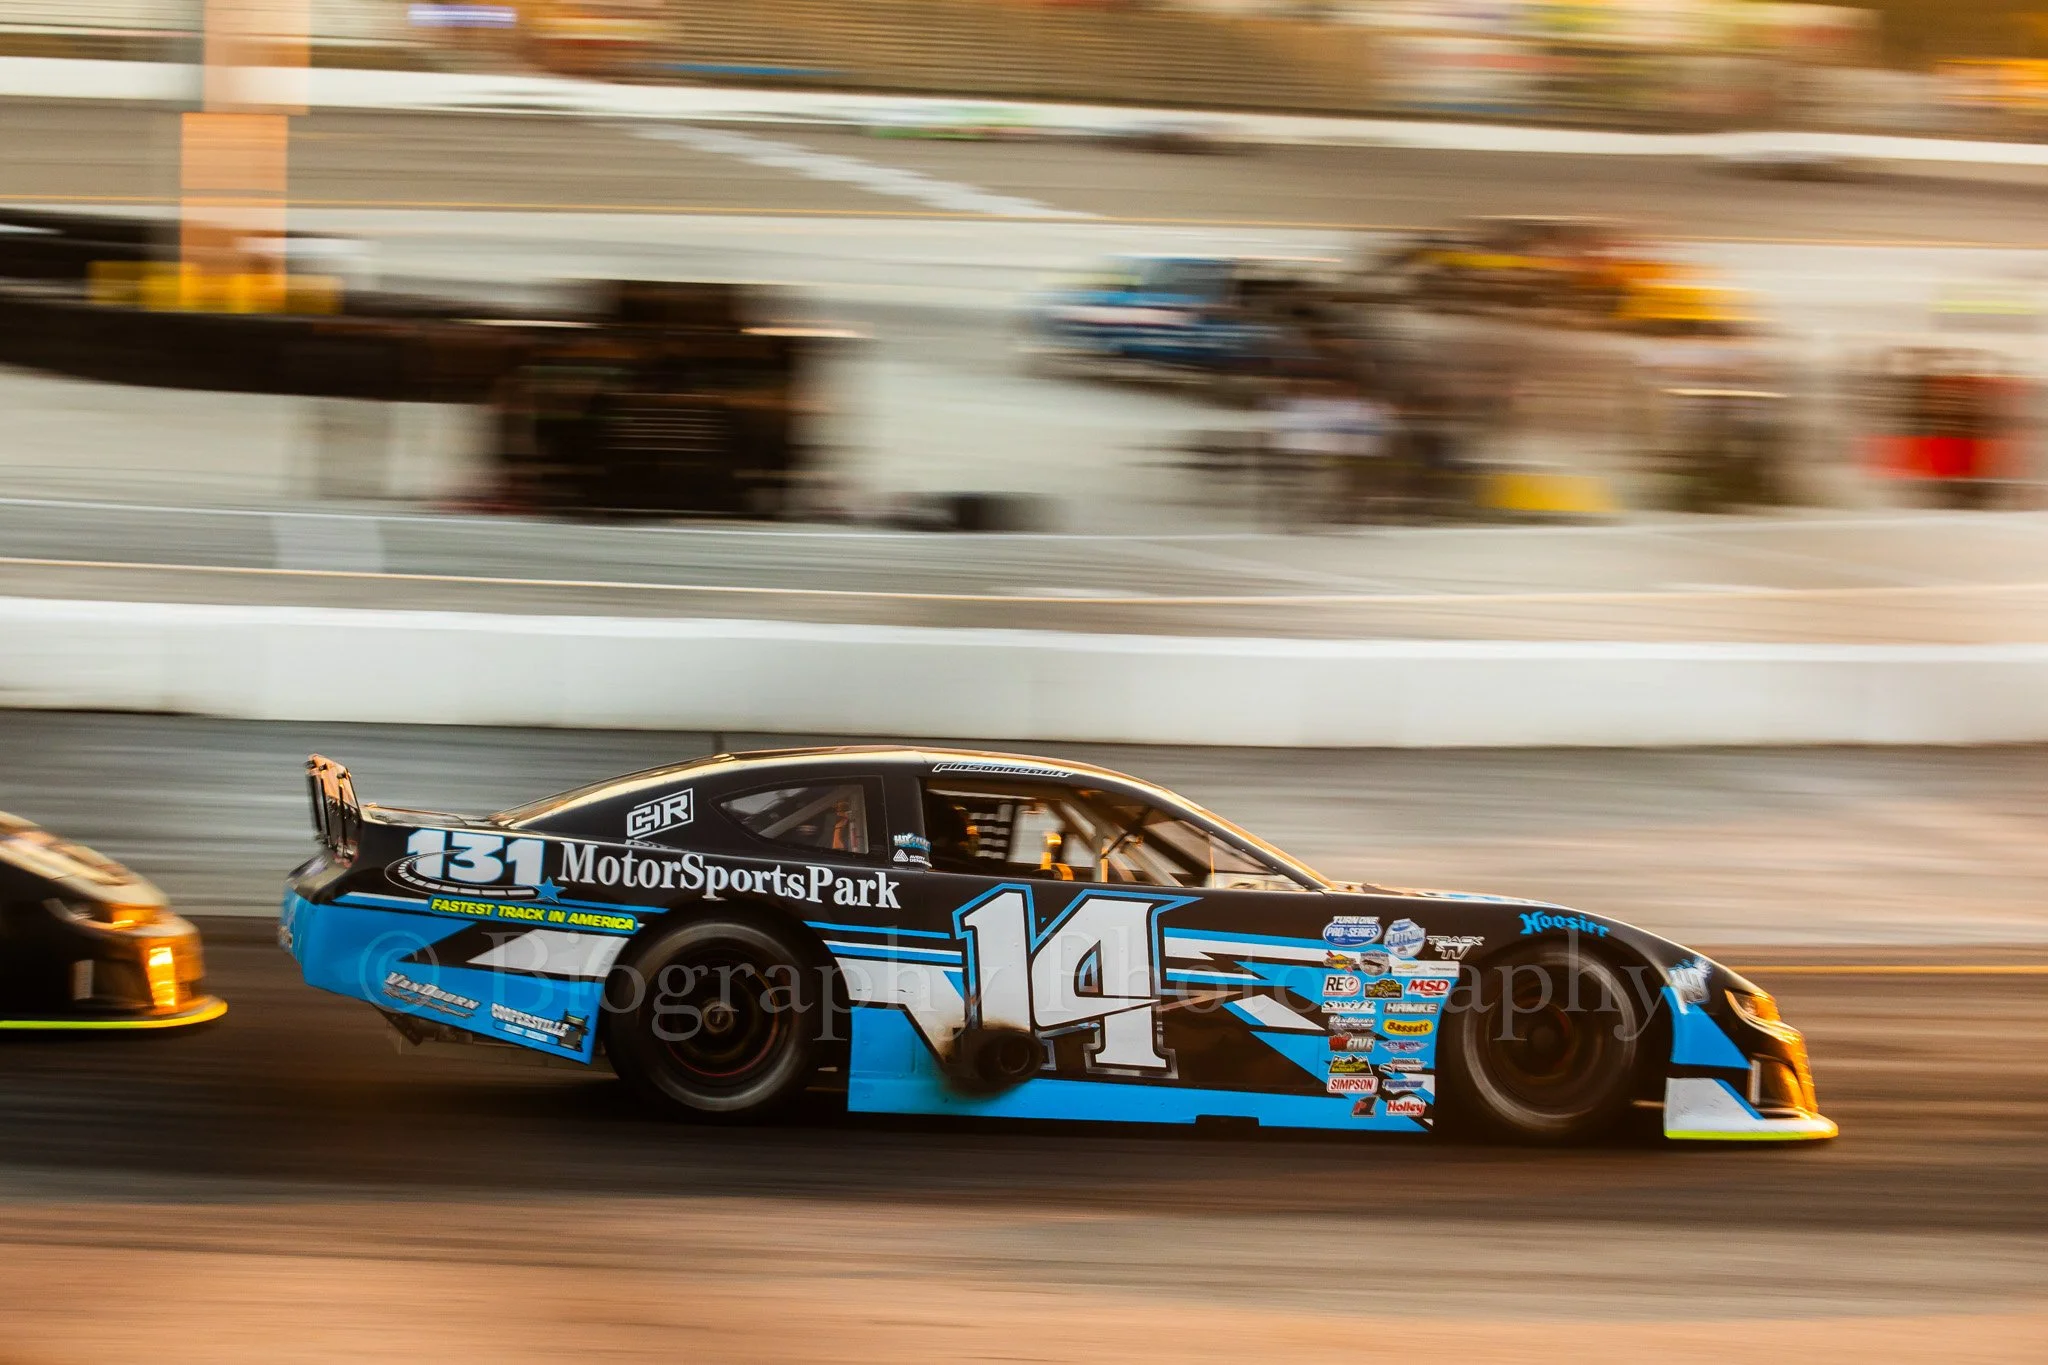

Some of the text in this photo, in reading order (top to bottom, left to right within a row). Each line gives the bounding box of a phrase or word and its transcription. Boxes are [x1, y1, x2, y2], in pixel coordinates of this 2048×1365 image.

[407, 828, 545, 886] 131
[431, 898, 634, 931] FASTEST TRACK IN AMERICA
[1326, 927, 1344, 937] PRO
[960, 888, 1170, 1070] 14
[1408, 979, 1449, 991] MSD
[1330, 1079, 1373, 1090] SIMPSON
[1387, 1101, 1425, 1115] Holley
